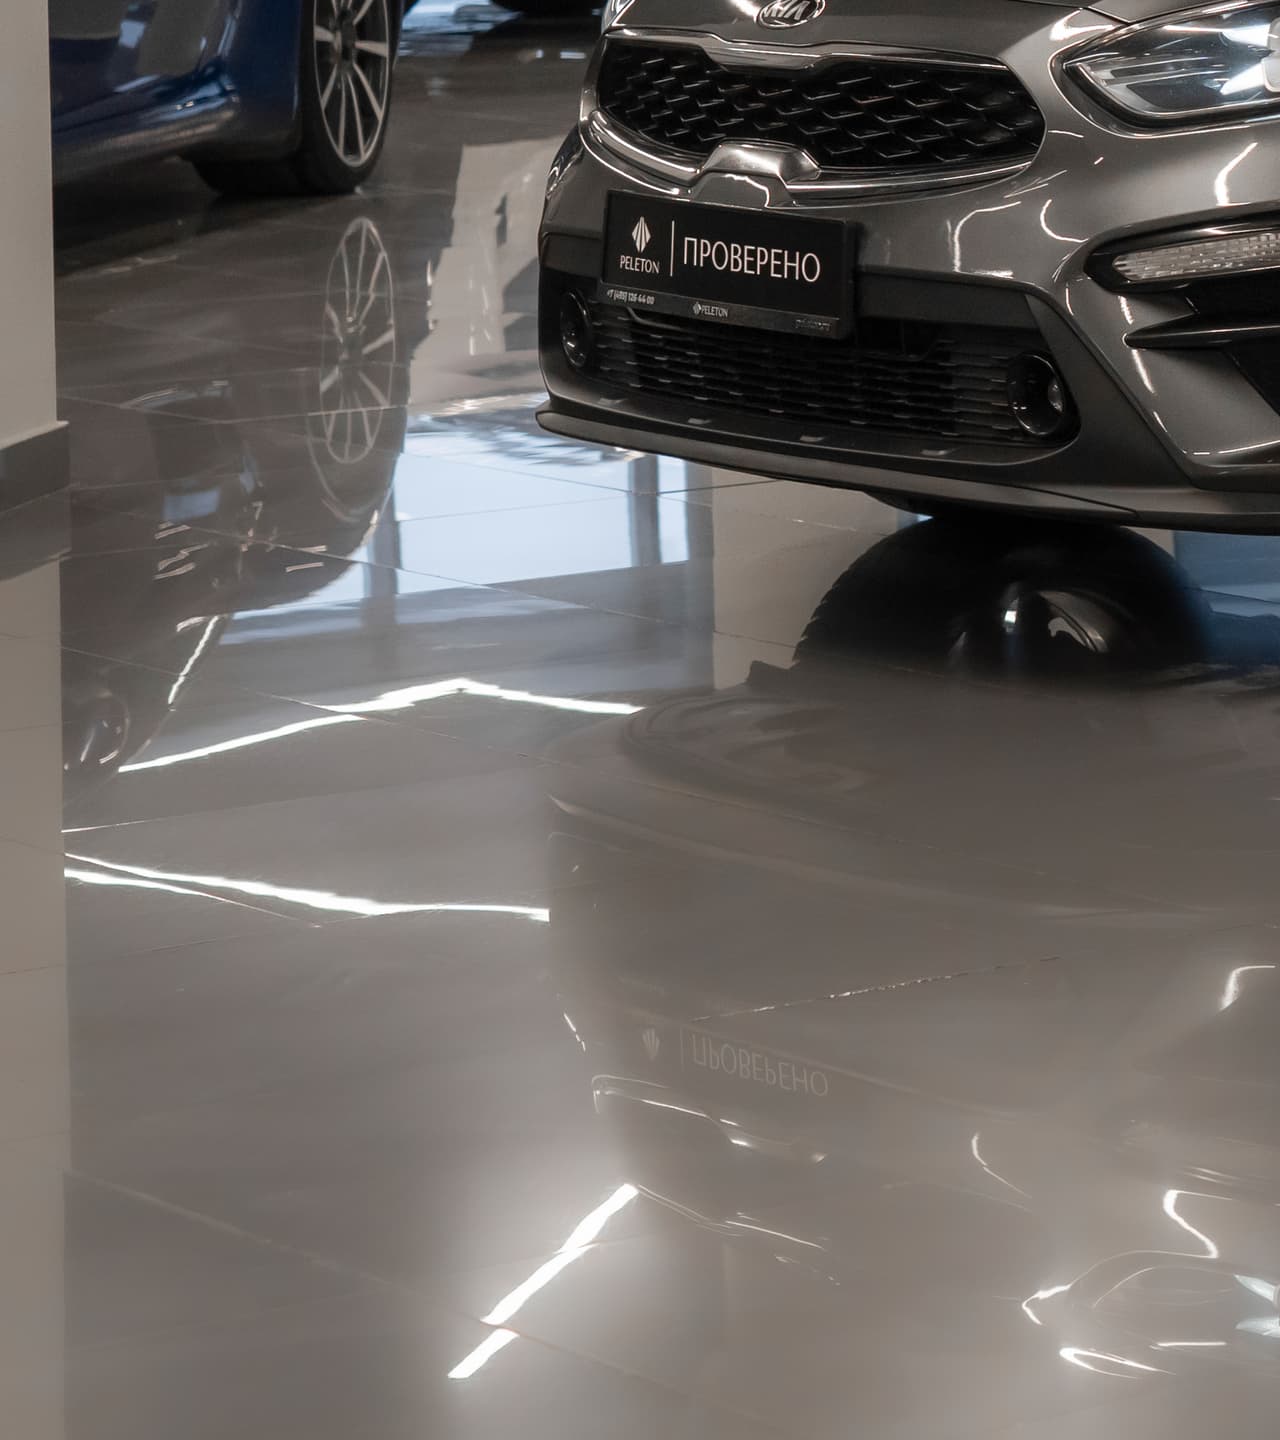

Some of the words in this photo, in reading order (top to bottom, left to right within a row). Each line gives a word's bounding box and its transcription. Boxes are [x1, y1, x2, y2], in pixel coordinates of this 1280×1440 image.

[619, 254, 660, 274] PELETON
[683, 236, 821, 283] ПРОВЕРЕНО
[700, 304, 728, 317] PELETON
